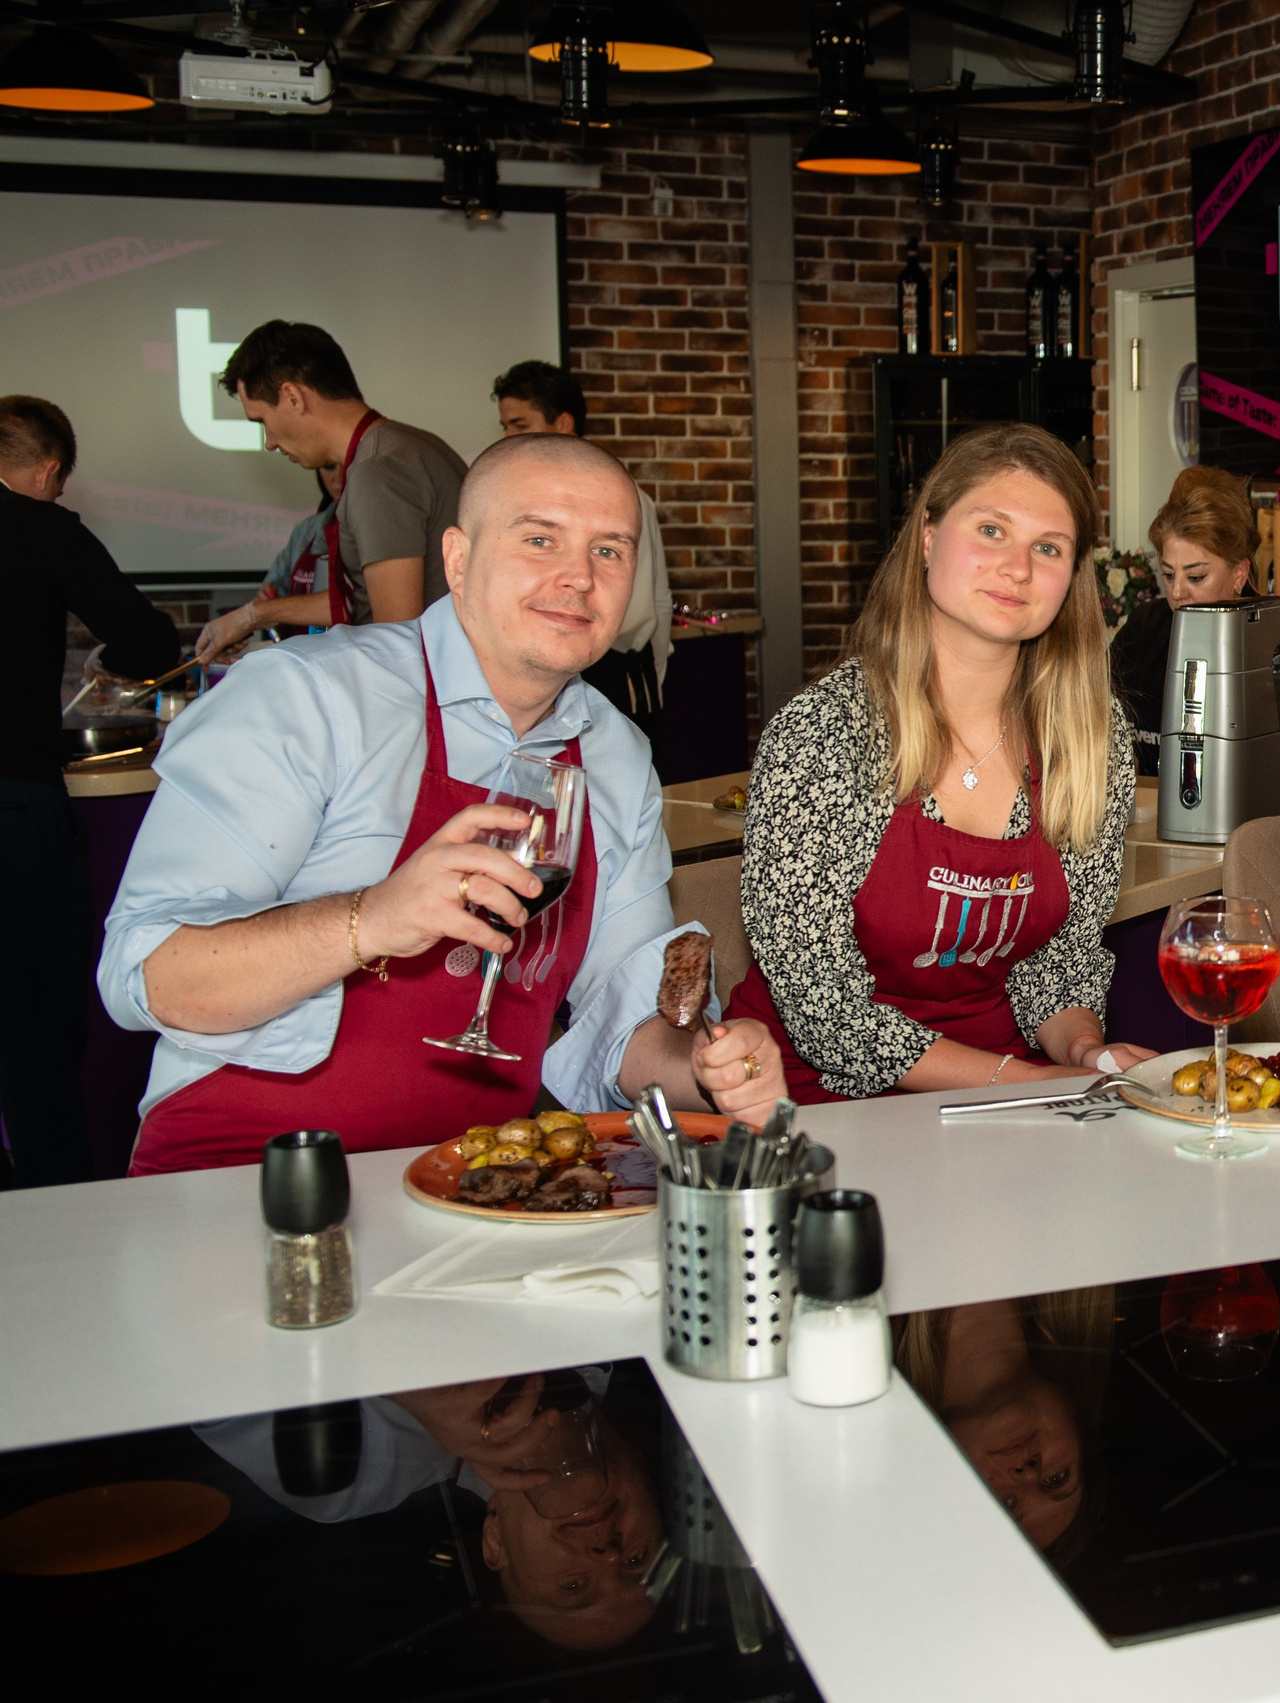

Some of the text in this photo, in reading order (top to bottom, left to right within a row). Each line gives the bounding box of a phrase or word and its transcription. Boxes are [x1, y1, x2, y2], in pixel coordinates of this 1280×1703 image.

[1200, 381, 1225, 405] ame
[1228, 393, 1239, 411] of
[1242, 397, 1277, 428] Taste:
